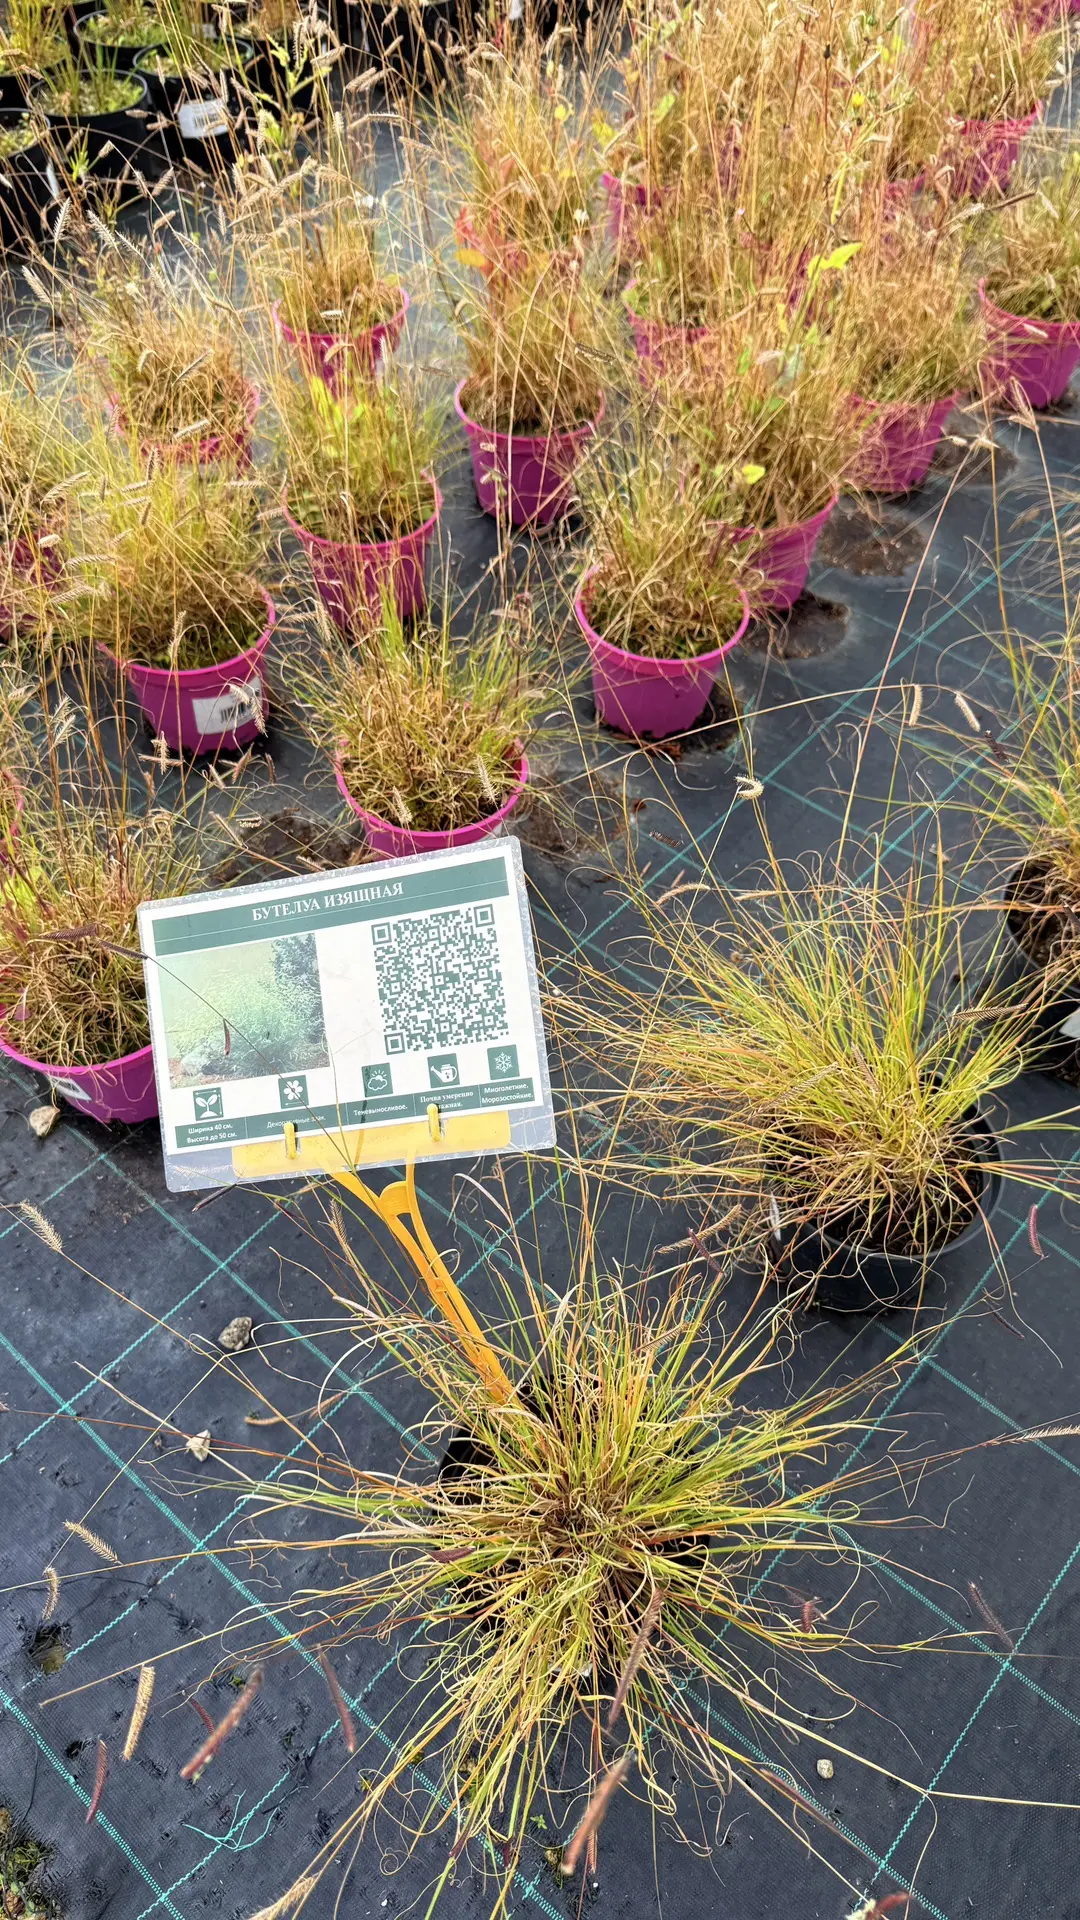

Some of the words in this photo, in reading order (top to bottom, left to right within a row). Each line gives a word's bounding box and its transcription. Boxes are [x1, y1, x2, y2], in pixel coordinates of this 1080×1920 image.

[252, 899, 321, 921] БУТЕЛУА
[324, 882, 404, 908] ИЗЯЩНАЯ
[484, 1083, 529, 1093] Многолетние.
[442, 1091, 474, 1101] умеренно
[482, 1092, 534, 1103] Морозостойкие.
[353, 1104, 408, 1116] Теневыносливое.
[188, 1126, 213, 1134] Ширина
